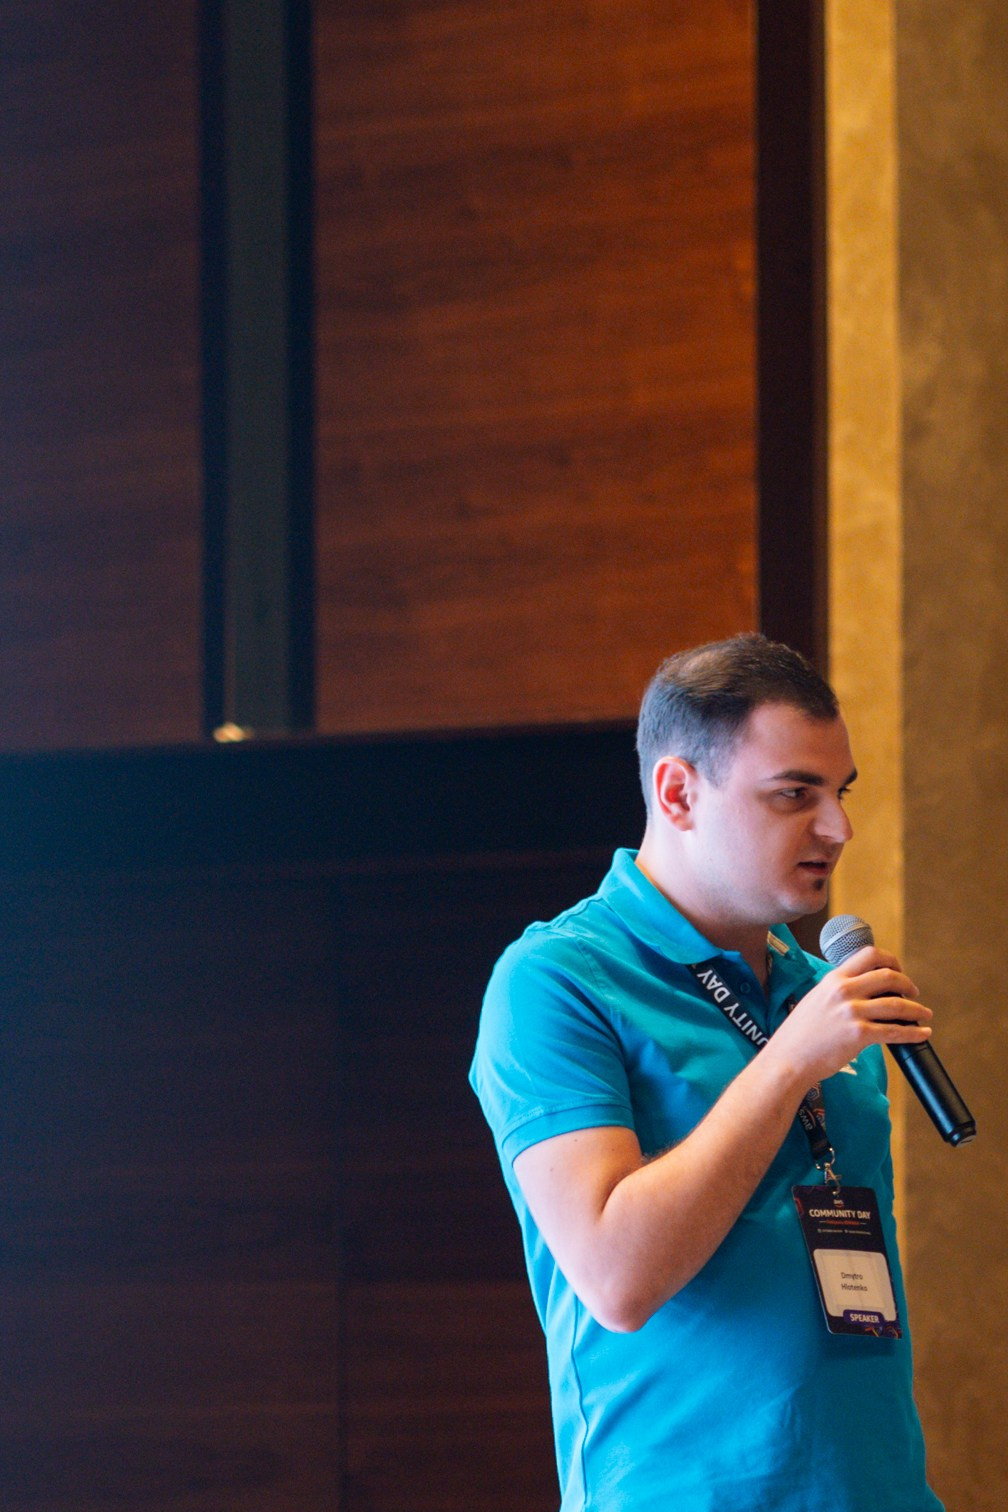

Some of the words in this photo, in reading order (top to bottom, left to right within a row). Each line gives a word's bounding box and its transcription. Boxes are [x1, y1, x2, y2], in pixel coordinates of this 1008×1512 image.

[697, 967, 731, 1003] DAY
[809, 1208, 856, 1218] COMMUNITY
[857, 1210, 871, 1219] DAY
[850, 1314, 880, 1323] SPEAKER
